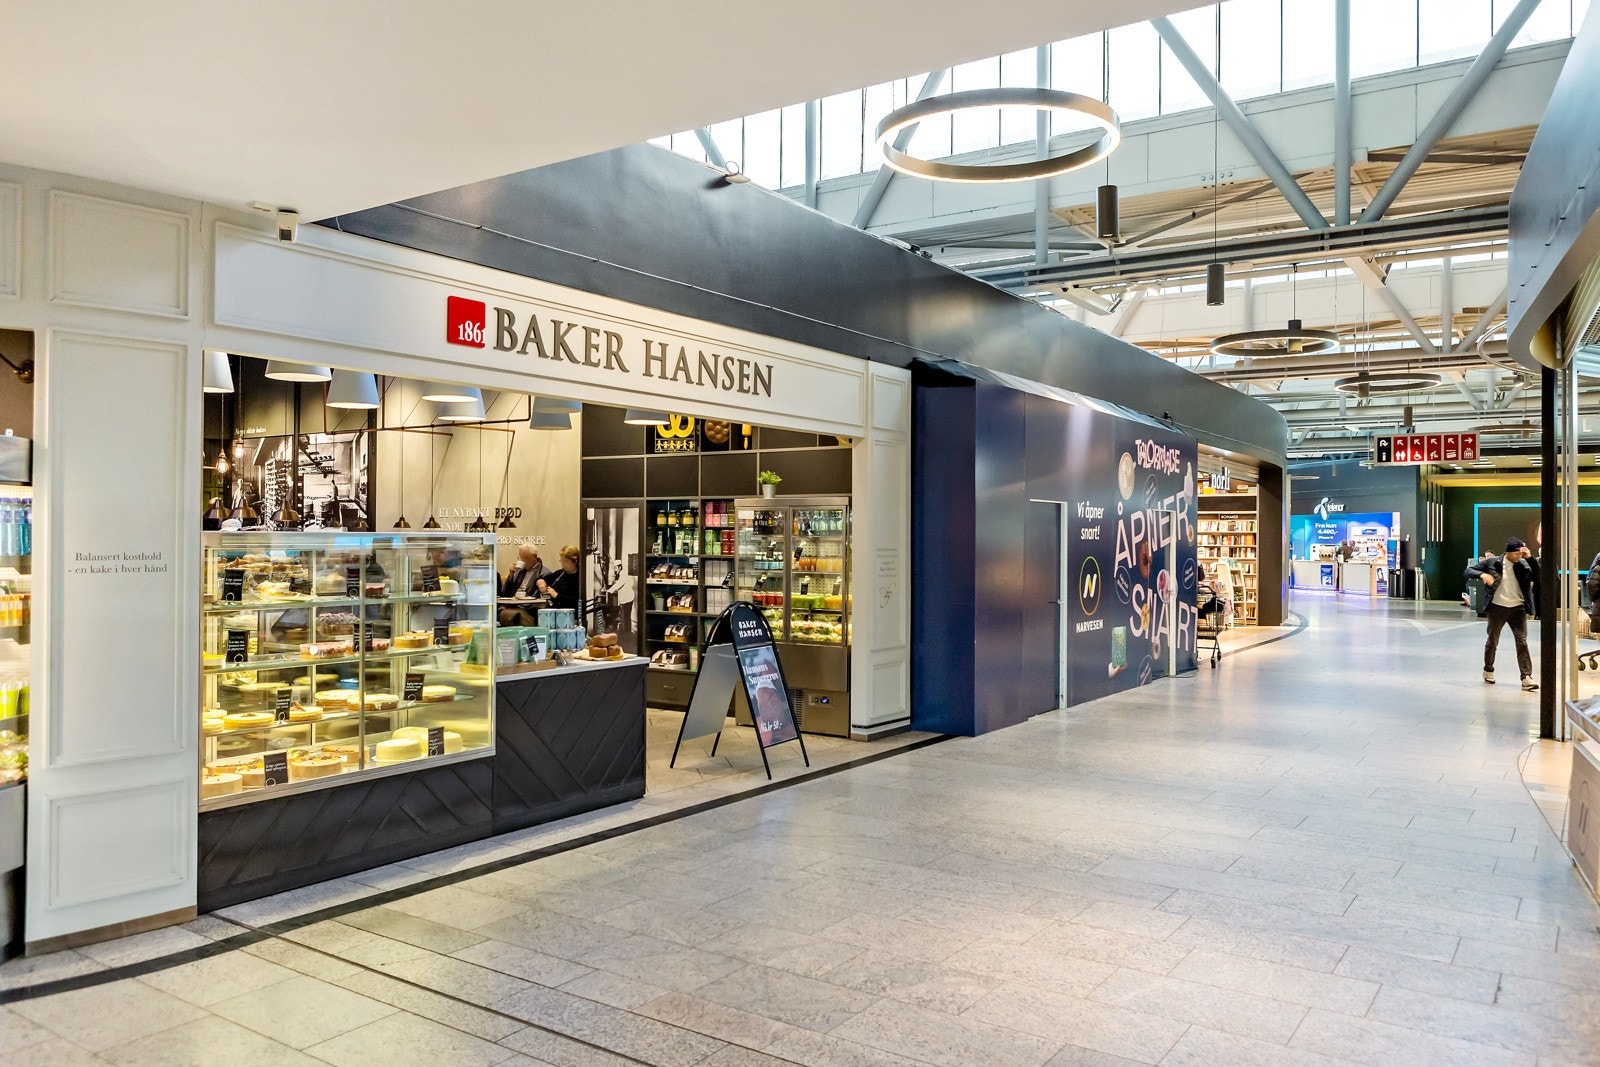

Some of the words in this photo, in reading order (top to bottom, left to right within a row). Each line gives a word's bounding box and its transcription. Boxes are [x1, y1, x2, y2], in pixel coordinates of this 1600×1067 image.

[493, 307, 630, 373] BAKER
[642, 339, 774, 398] HANSEN
[1211, 467, 1230, 490] norli
[439, 508, 450, 518] ET
[453, 508, 491, 519] NYBAKT
[495, 507, 521, 518] BRØD
[1077, 502, 1085, 518] Vi
[1085, 501, 1104, 522] åpner
[1327, 503, 1344, 511] telenor
[1081, 525, 1100, 540] snart!
[1114, 491, 1189, 578] ÅPNER
[497, 536, 512, 546] PRØ
[514, 536, 546, 546] SKORPE
[75, 552, 120, 561] Balansert
[123, 552, 162, 561] kosthold
[90, 565, 112, 573] kake
[121, 564, 141, 572] hver
[144, 564, 167, 572] hånd
[1130, 583, 1198, 653] SNART
[1076, 619, 1103, 633] NARVESEN
